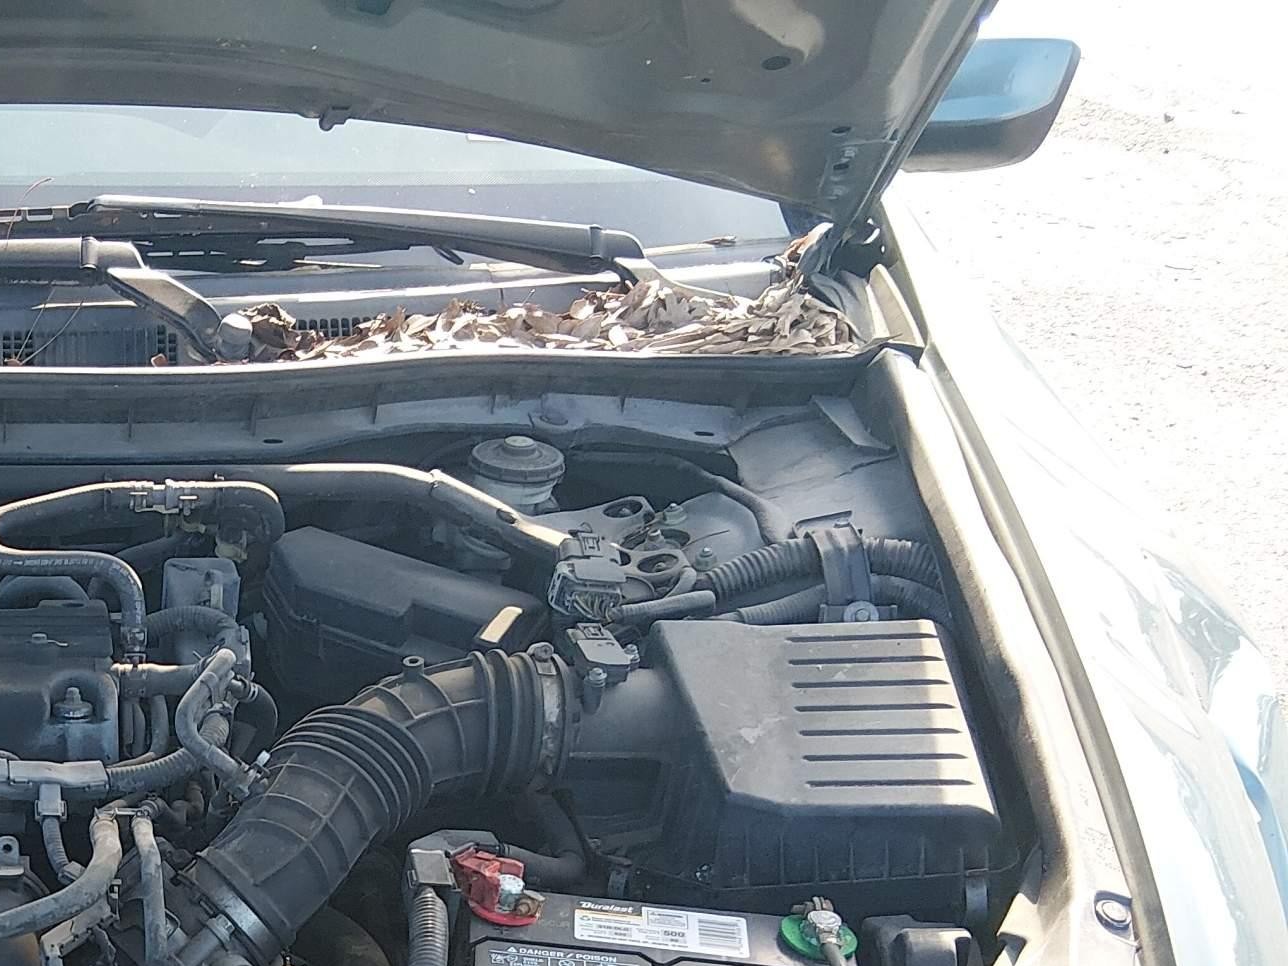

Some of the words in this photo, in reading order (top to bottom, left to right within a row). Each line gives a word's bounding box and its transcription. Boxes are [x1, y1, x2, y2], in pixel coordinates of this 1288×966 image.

[579, 901, 634, 914] Duralast
[519, 947, 564, 958] DANGER
[575, 953, 617, 963] POISON
